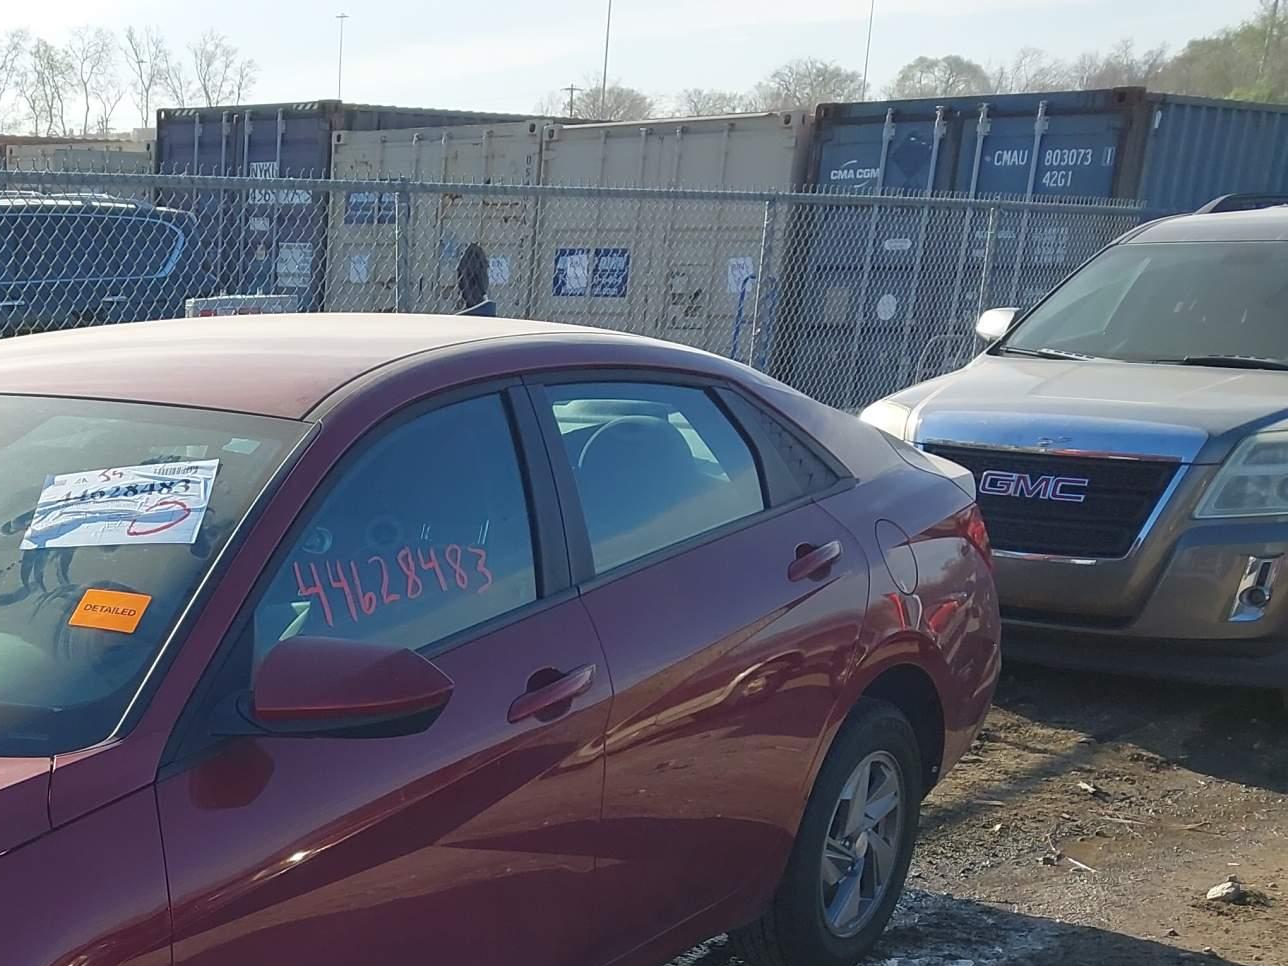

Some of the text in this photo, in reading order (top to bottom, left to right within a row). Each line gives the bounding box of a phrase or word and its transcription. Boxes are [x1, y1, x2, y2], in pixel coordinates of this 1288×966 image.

[993, 149, 1029, 167] CMAU
[1044, 149, 1093, 166] 803073
[830, 168, 880, 181] CMA CGM
[1042, 170, 1073, 187] 42G1
[979, 470, 1089, 502] GMC
[293, 543, 493, 628] 44628483
[83, 603, 137, 617] DETAILED
